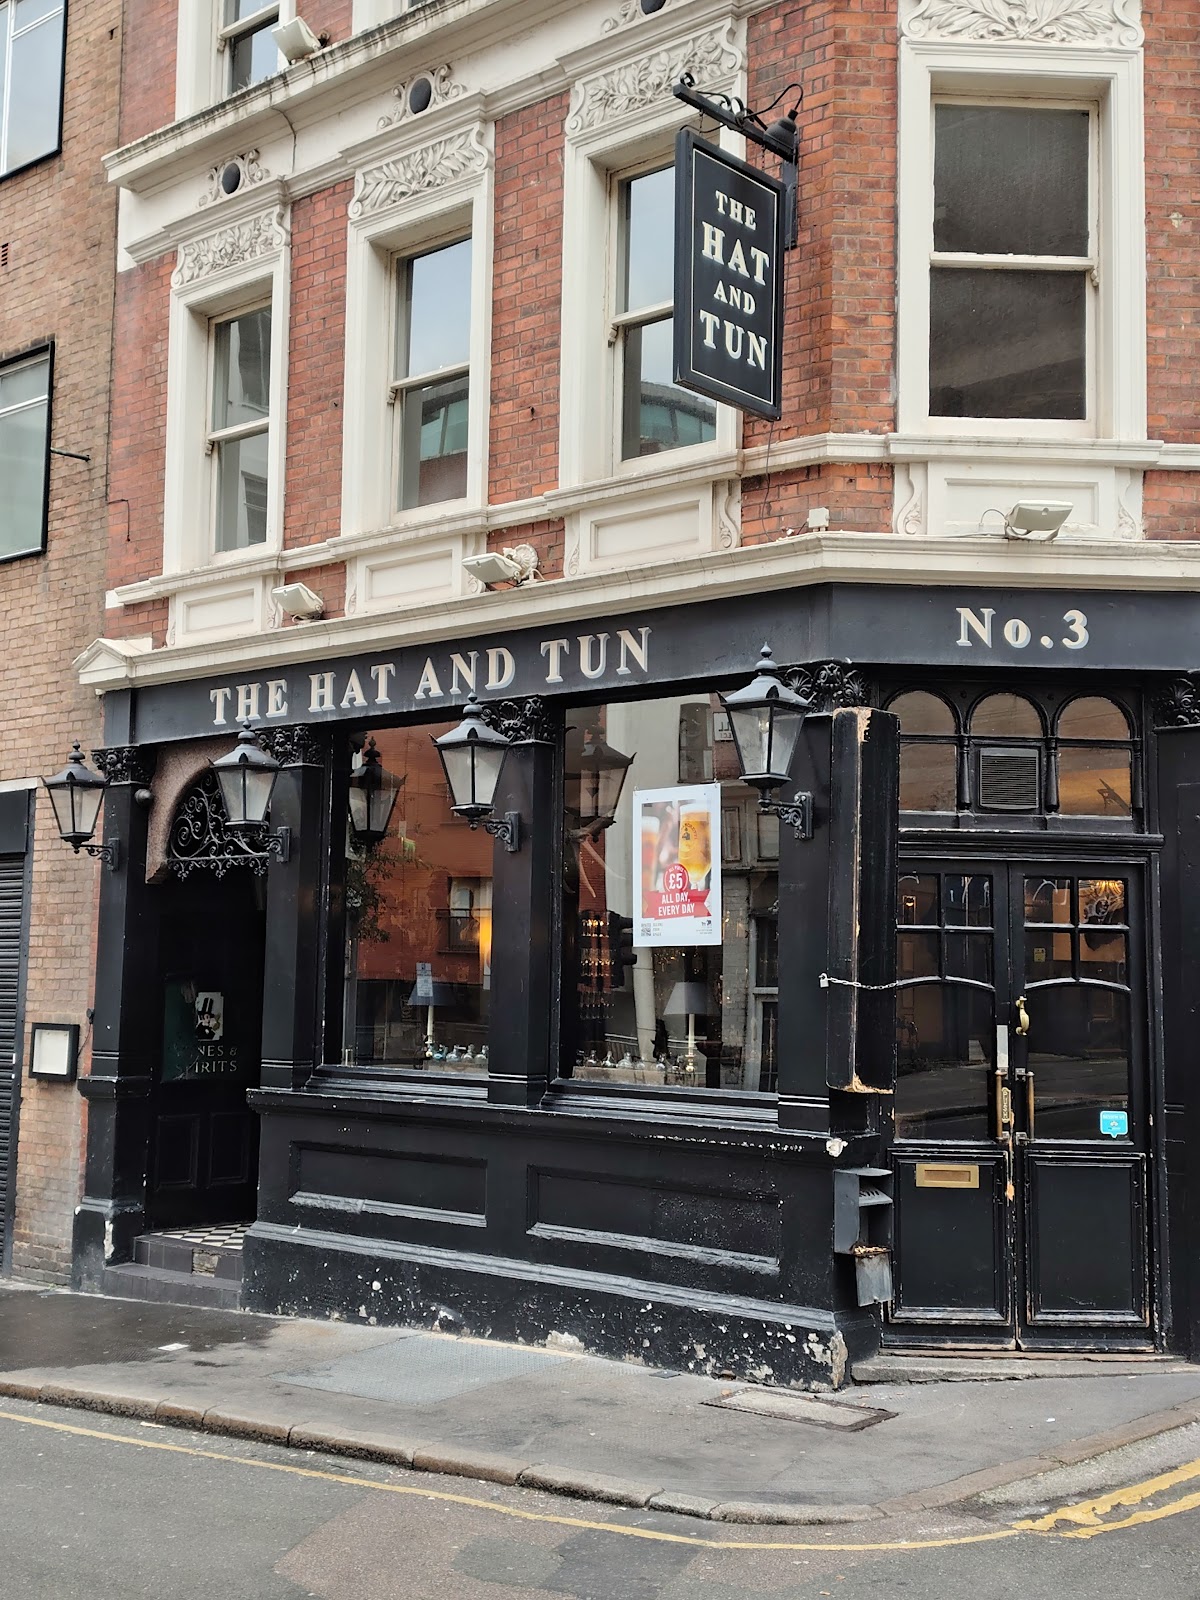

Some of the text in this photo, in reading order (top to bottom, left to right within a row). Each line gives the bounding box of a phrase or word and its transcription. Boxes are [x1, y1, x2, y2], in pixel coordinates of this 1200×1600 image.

[715, 189, 757, 231] THE
[701, 221, 770, 286] HAT
[713, 280, 756, 315] AND
[699, 309, 768, 371] TUN
[955, 607, 1090, 650] No.3
[209, 626, 651, 726] THE HAT AND TUN
[662, 892, 690, 904] ALL DAY,
[668, 872, 683, 890] £5
[658, 903, 694, 916] EVERY DAY
[229, 1046, 238, 1056] &
